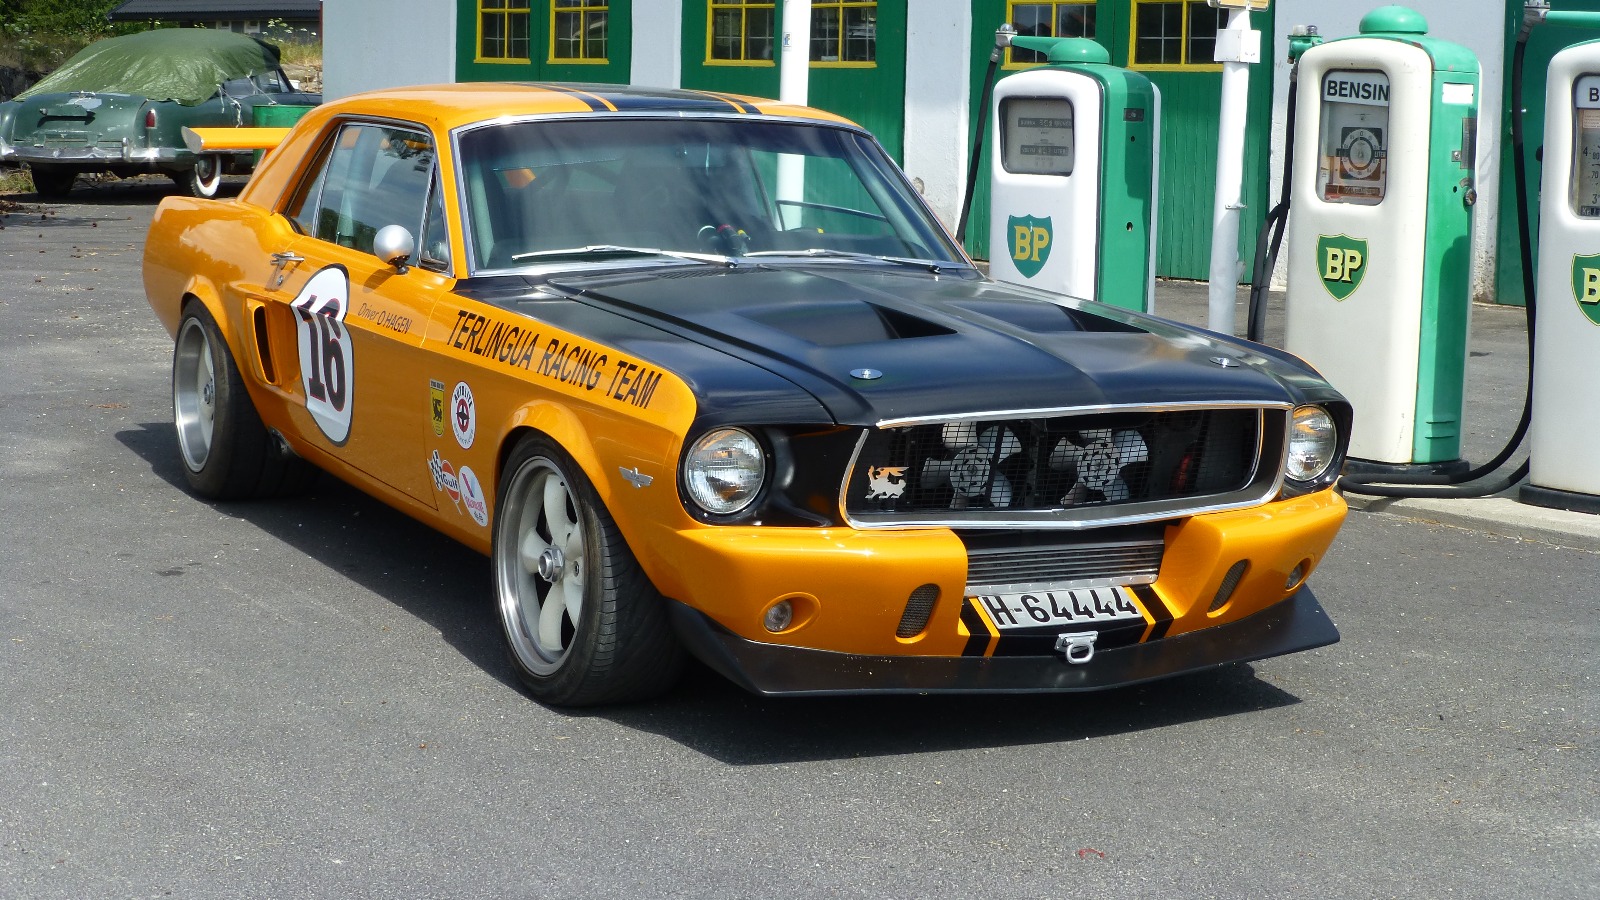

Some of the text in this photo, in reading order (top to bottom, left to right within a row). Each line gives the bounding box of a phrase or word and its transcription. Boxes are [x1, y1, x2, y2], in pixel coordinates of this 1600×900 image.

[1327, 80, 1389, 101] BENSIN
[1013, 225, 1050, 262] BP
[1323, 247, 1363, 284] BP
[357, 302, 380, 320] Driver
[383, 312, 413, 335] HAGEN
[297, 294, 347, 412] 16
[447, 310, 663, 410] TERLINGUA RACING TEAM
[984, 587, 1138, 626] H-64444
